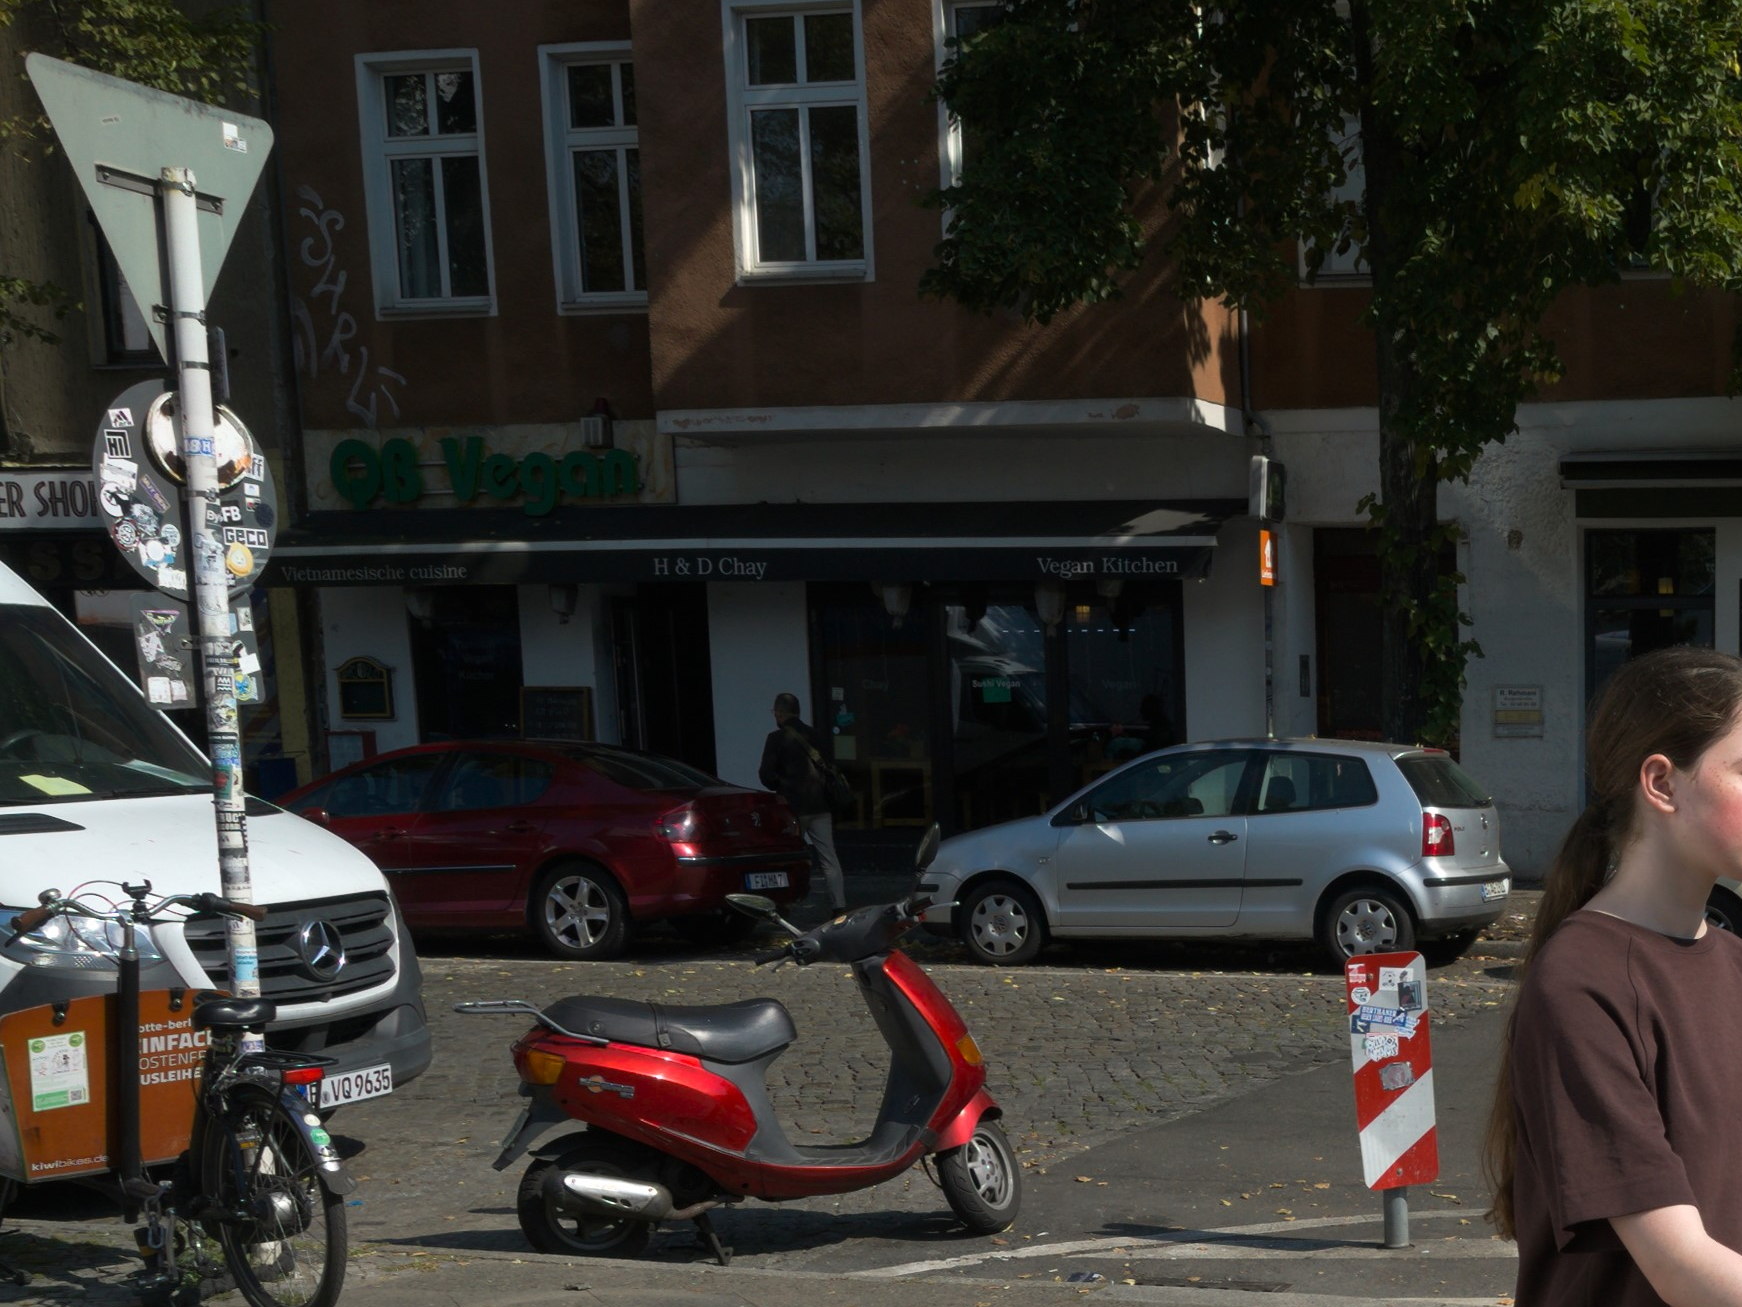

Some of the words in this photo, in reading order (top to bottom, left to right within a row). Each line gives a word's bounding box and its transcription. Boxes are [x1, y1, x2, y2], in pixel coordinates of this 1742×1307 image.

[440, 436, 639, 516] Vegan
[281, 564, 406, 583] Vietnamesische
[410, 563, 467, 582] cuisine
[653, 557, 667, 576] H
[674, 557, 691, 576] &
[697, 557, 713, 576] D
[718, 556, 767, 580] Chay
[1037, 557, 1094, 579] Vegan
[1101, 555, 1178, 575] Kitchen
[996, 679, 1021, 690] Vegan
[139, 1018, 192, 1034] otte-berl
[139, 1030, 213, 1054] INFAC
[139, 1050, 208, 1070] OSTENF
[140, 1066, 203, 1085] USLEIHE
[331, 1077, 352, 1101] VQ
[355, 1068, 390, 1096] 9635
[32, 1154, 110, 1171] kiwibikes.de
